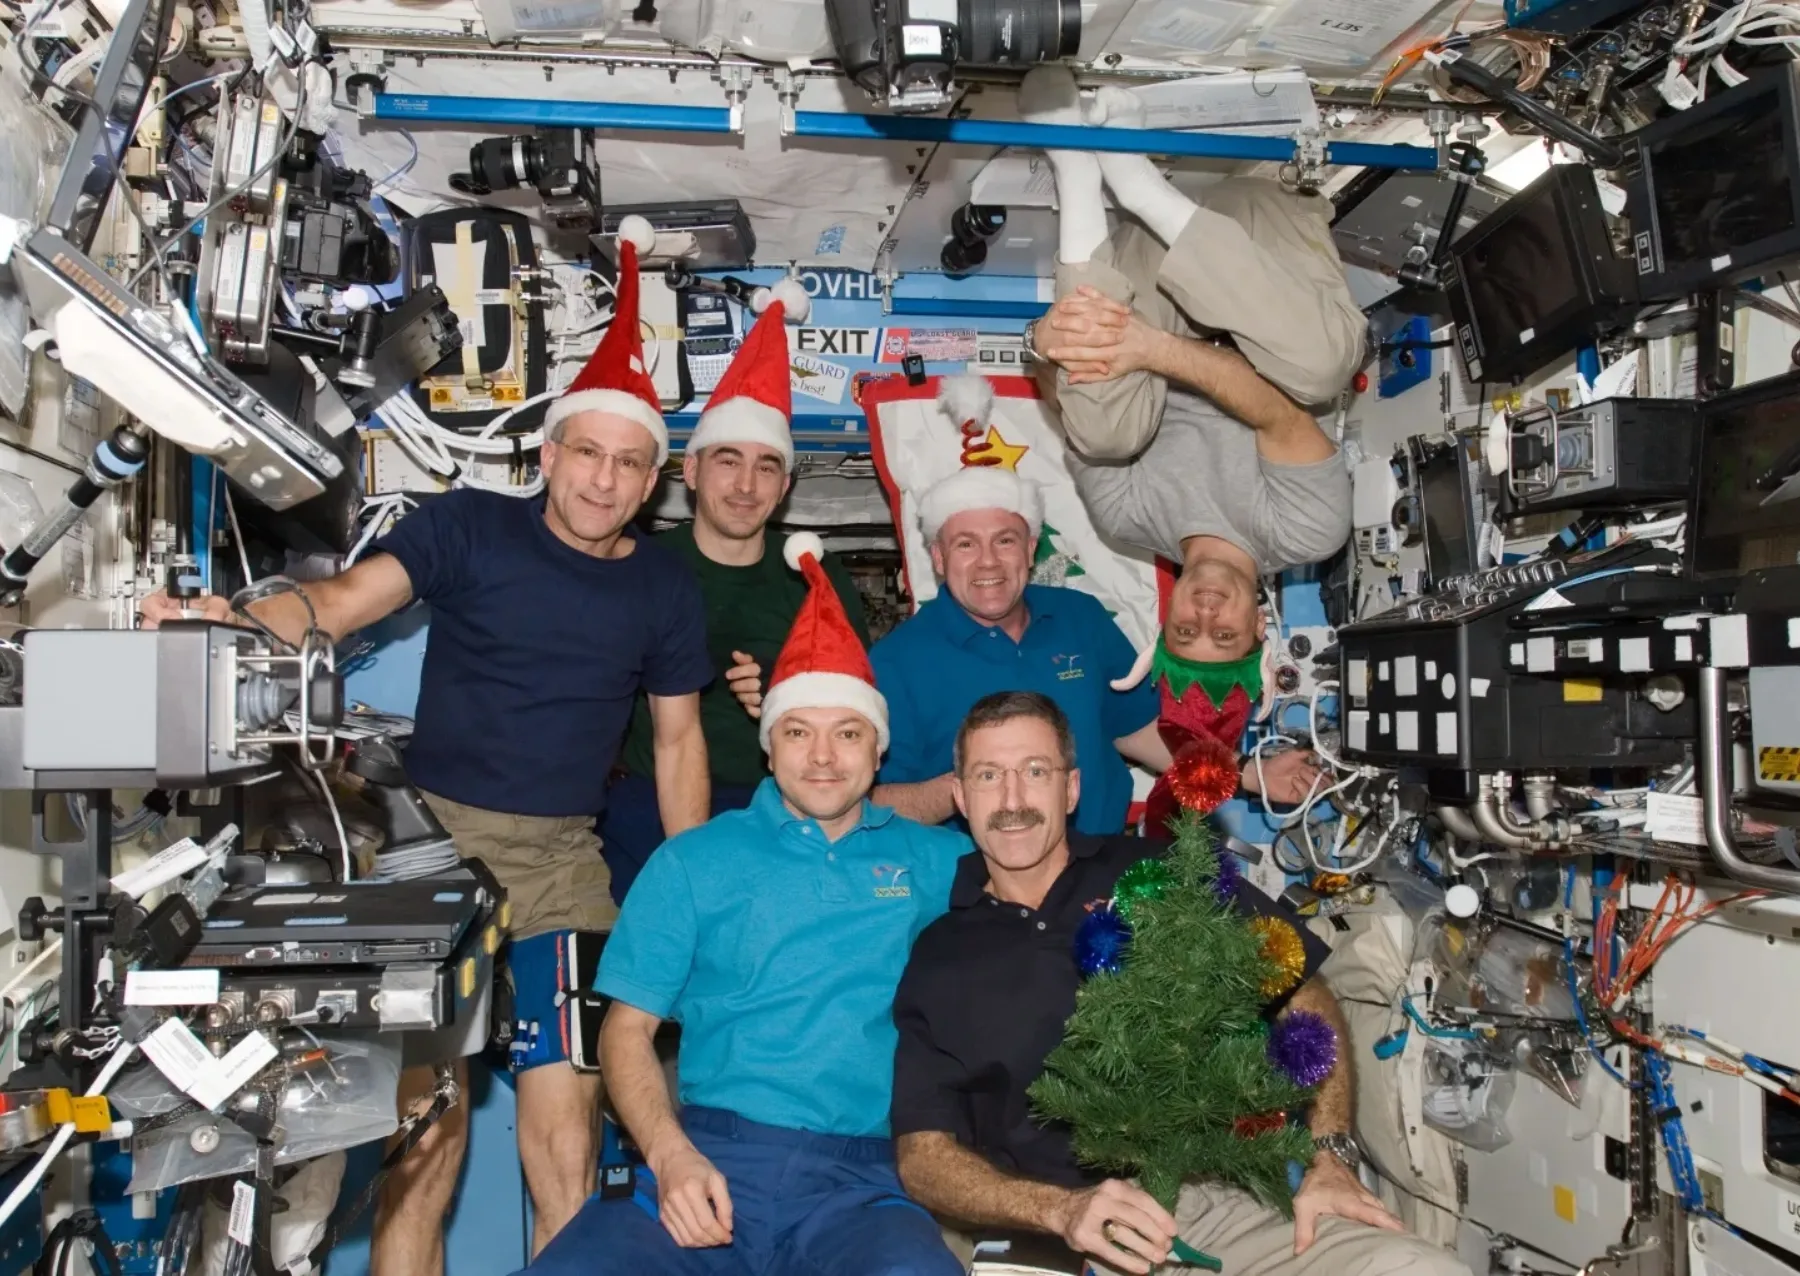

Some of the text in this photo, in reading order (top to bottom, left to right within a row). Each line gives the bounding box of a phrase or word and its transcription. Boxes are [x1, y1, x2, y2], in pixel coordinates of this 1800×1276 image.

[1331, 22, 1363, 32] SET
[797, 328, 869, 354] EXIT
[793, 355, 846, 380] GUARD
[800, 379, 826, 396] best!
